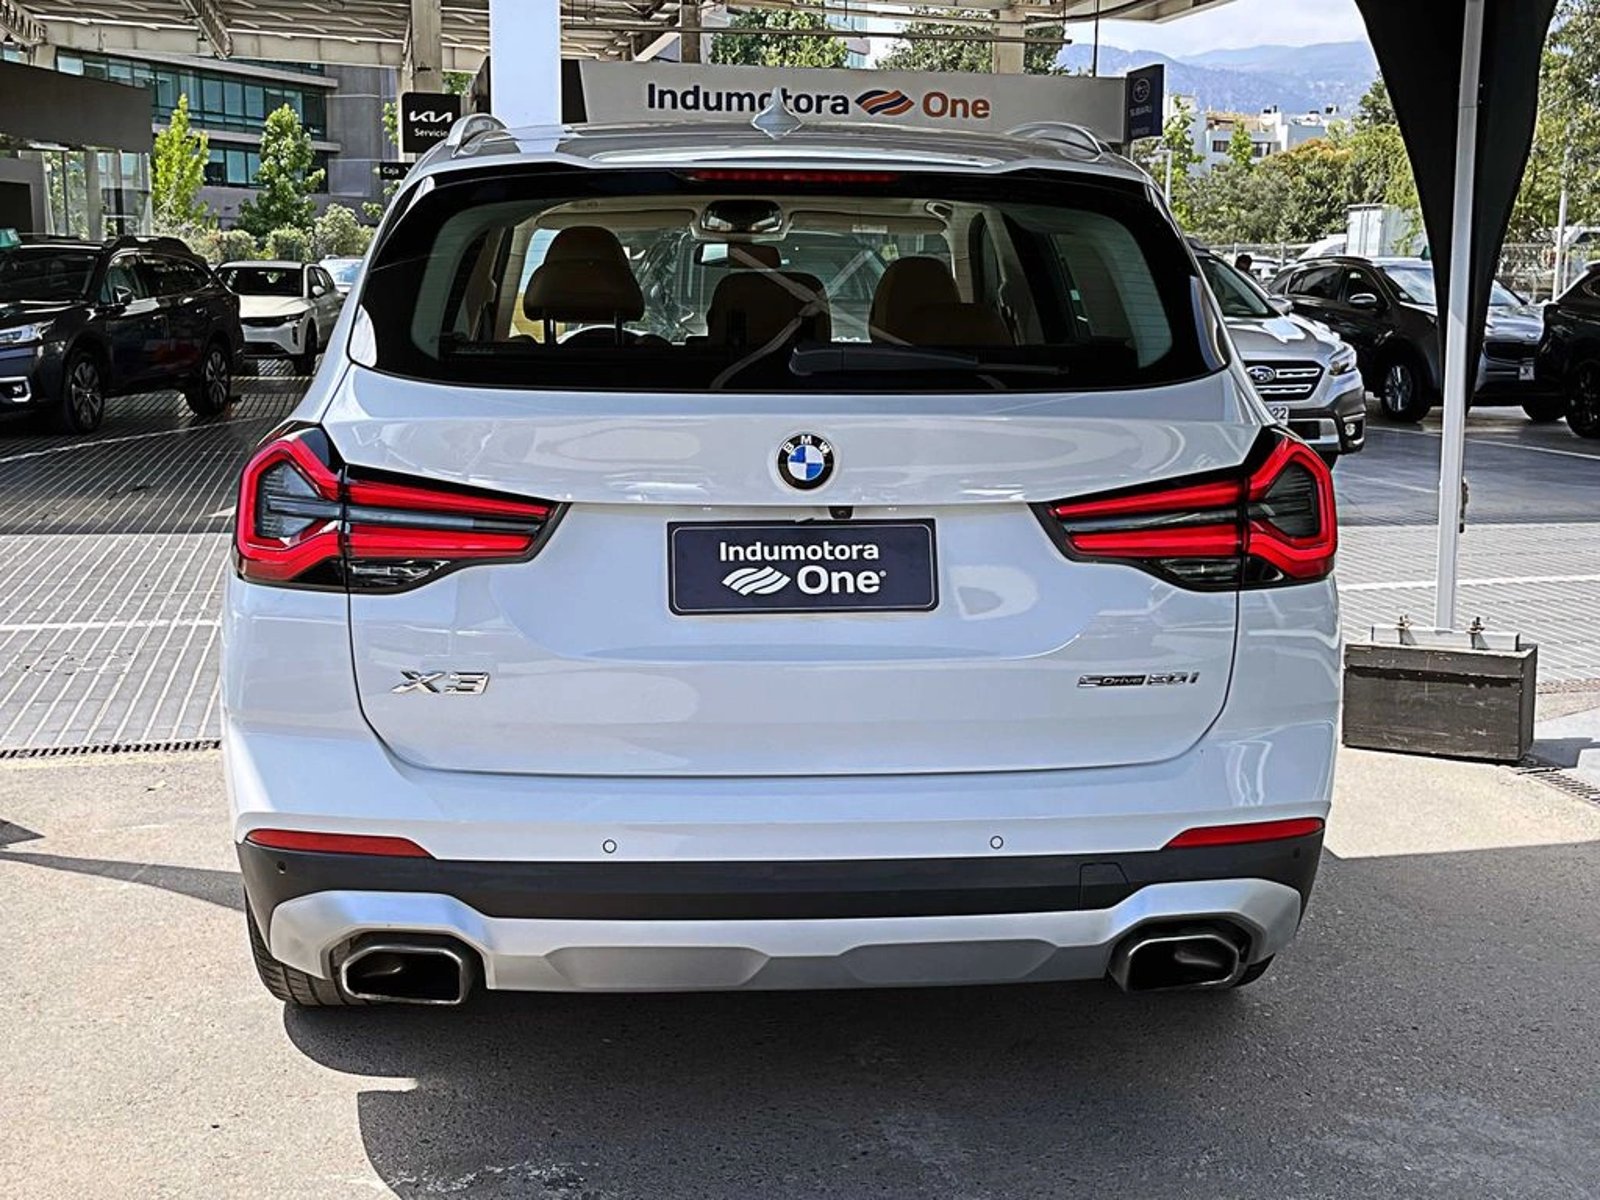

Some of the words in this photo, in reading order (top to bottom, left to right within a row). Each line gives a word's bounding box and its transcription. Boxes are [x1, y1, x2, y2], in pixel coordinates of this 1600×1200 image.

[648, 83, 850, 115] Indumotora
[922, 91, 990, 119] One
[414, 127, 449, 138] Servicio
[382, 166, 399, 175] Caja
[782, 435, 831, 454] BMW
[719, 541, 880, 562] Indumotora
[391, 671, 490, 695] X3
